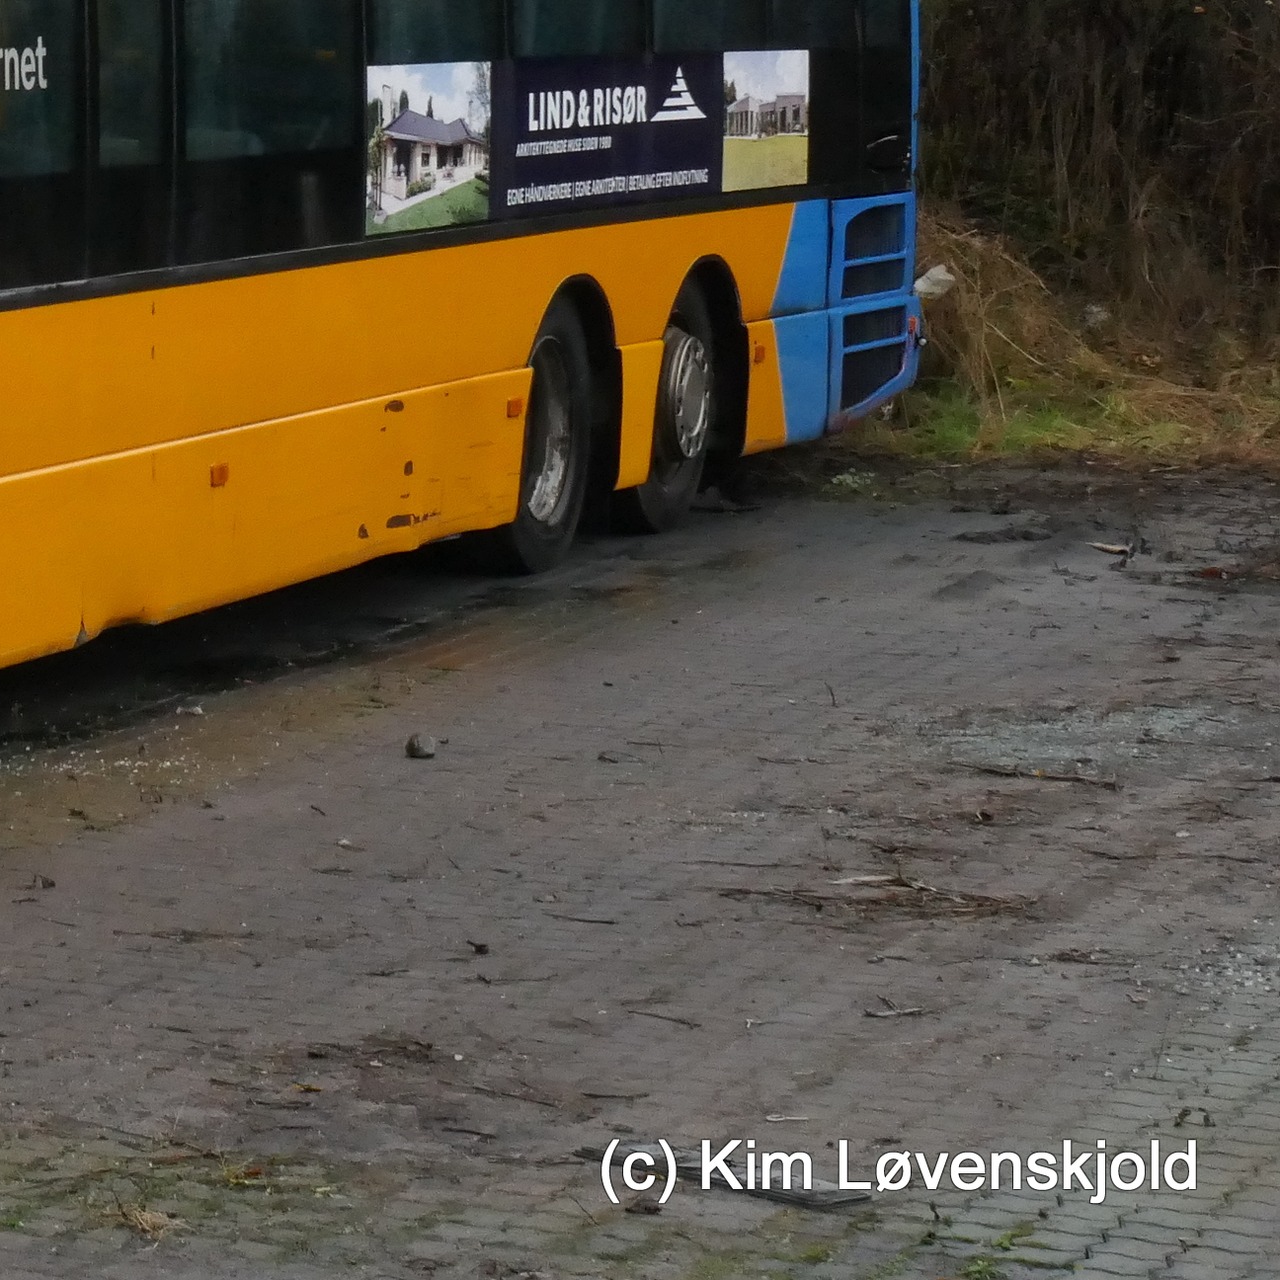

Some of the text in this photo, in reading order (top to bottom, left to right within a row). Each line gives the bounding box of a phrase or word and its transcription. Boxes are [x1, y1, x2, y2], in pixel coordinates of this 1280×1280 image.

[528, 85, 647, 131] LIND & RISØR
[506, 188, 524, 206] EGNE
[574, 182, 590, 199] EGNE
